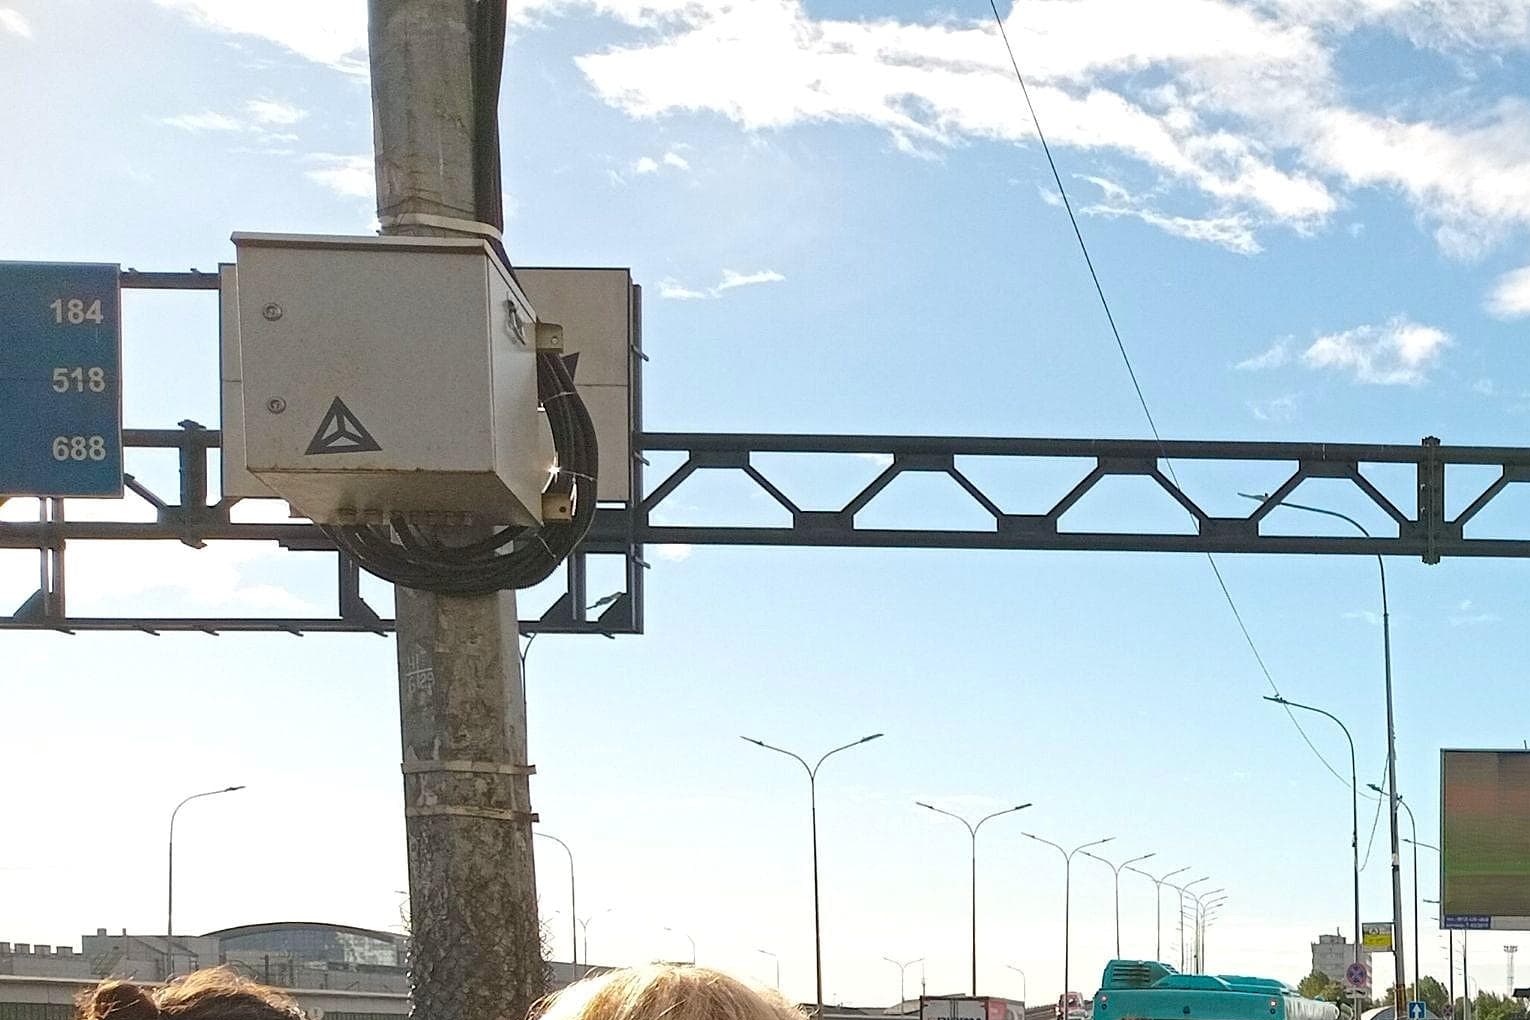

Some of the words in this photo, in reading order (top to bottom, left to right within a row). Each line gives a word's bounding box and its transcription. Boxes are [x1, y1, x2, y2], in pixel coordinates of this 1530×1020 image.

[50, 299, 104, 324] 184
[52, 367, 105, 393] 518
[52, 436, 106, 461] 688
